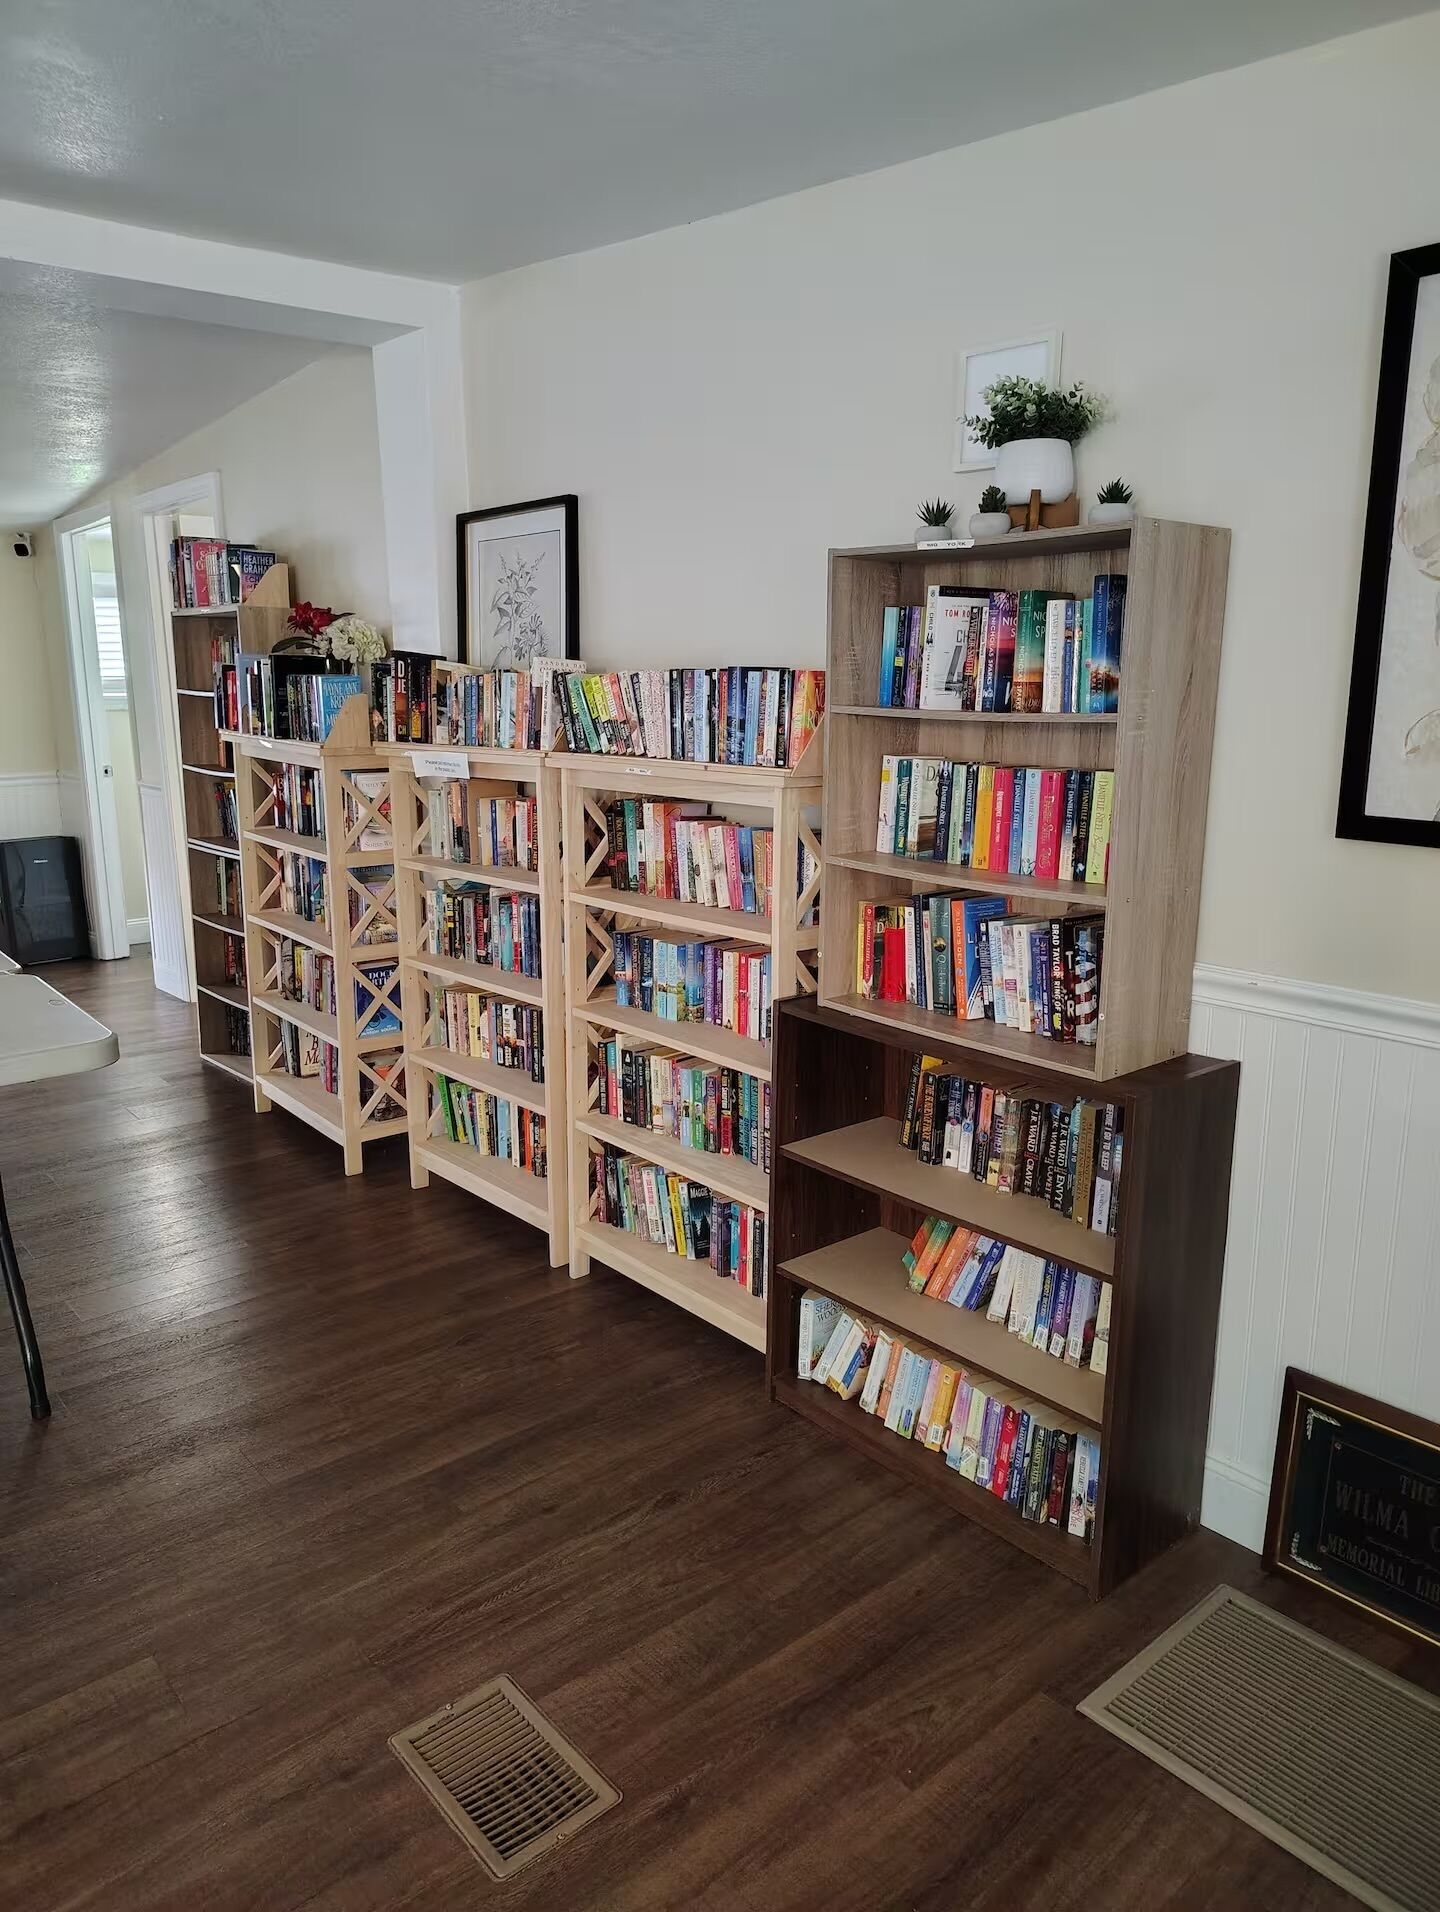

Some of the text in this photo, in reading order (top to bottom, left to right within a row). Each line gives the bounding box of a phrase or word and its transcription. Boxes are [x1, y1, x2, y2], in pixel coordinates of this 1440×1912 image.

[243, 554, 274, 566] HEATHER
[945, 609, 959, 618] TOM
[964, 618, 978, 676] WILBUR SMITH
[986, 617, 996, 685] NICHOLAS SPARKS
[1015, 682, 1023, 710] SPARKS
[938, 786, 949, 826] DANIELLE STEEL
[964, 779, 974, 823] DANIELLE STEEL
[1013, 785, 1021, 812] DANIELLE
[1064, 790, 1074, 834] DANIELLE STEEL
[1012, 813, 1020, 830] STEEL
[1079, 789, 1090, 838] DANIELLE STEEL
[937, 954, 947, 994] Quicksilver
[1051, 924, 1062, 1011] BRAD TAYLOR RING OF
[910, 1075, 918, 1095] SCOTT
[907, 1095, 915, 1119] TUROW
[1073, 1102, 1082, 1128] WOMAN
[1105, 1103, 1114, 1125] BEFORE
[994, 1117, 1004, 1153] LEATHER
[1026, 1123, 1039, 1151] WARD
[1048, 1130, 1058, 1158] WARD
[1102, 1141, 1111, 1150] TO
[1103, 1131, 1112, 1139] GO
[1056, 1138, 1067, 1166] WARD
[1101, 1150, 1111, 1170] SLEEP
[1023, 1158, 1035, 1187] CRAVE
[1044, 1165, 1055, 1193] COVET
[689, 1187, 708, 1199] MAGGIE
[1053, 1174, 1065, 1203] ENVY
[1014, 1425, 1026, 1468] MAISEY YATES
[1031, 1464, 1040, 1484] YATES
[1336, 1480, 1409, 1538] WILMA
[1326, 1533, 1406, 1587] MEMORIAL
